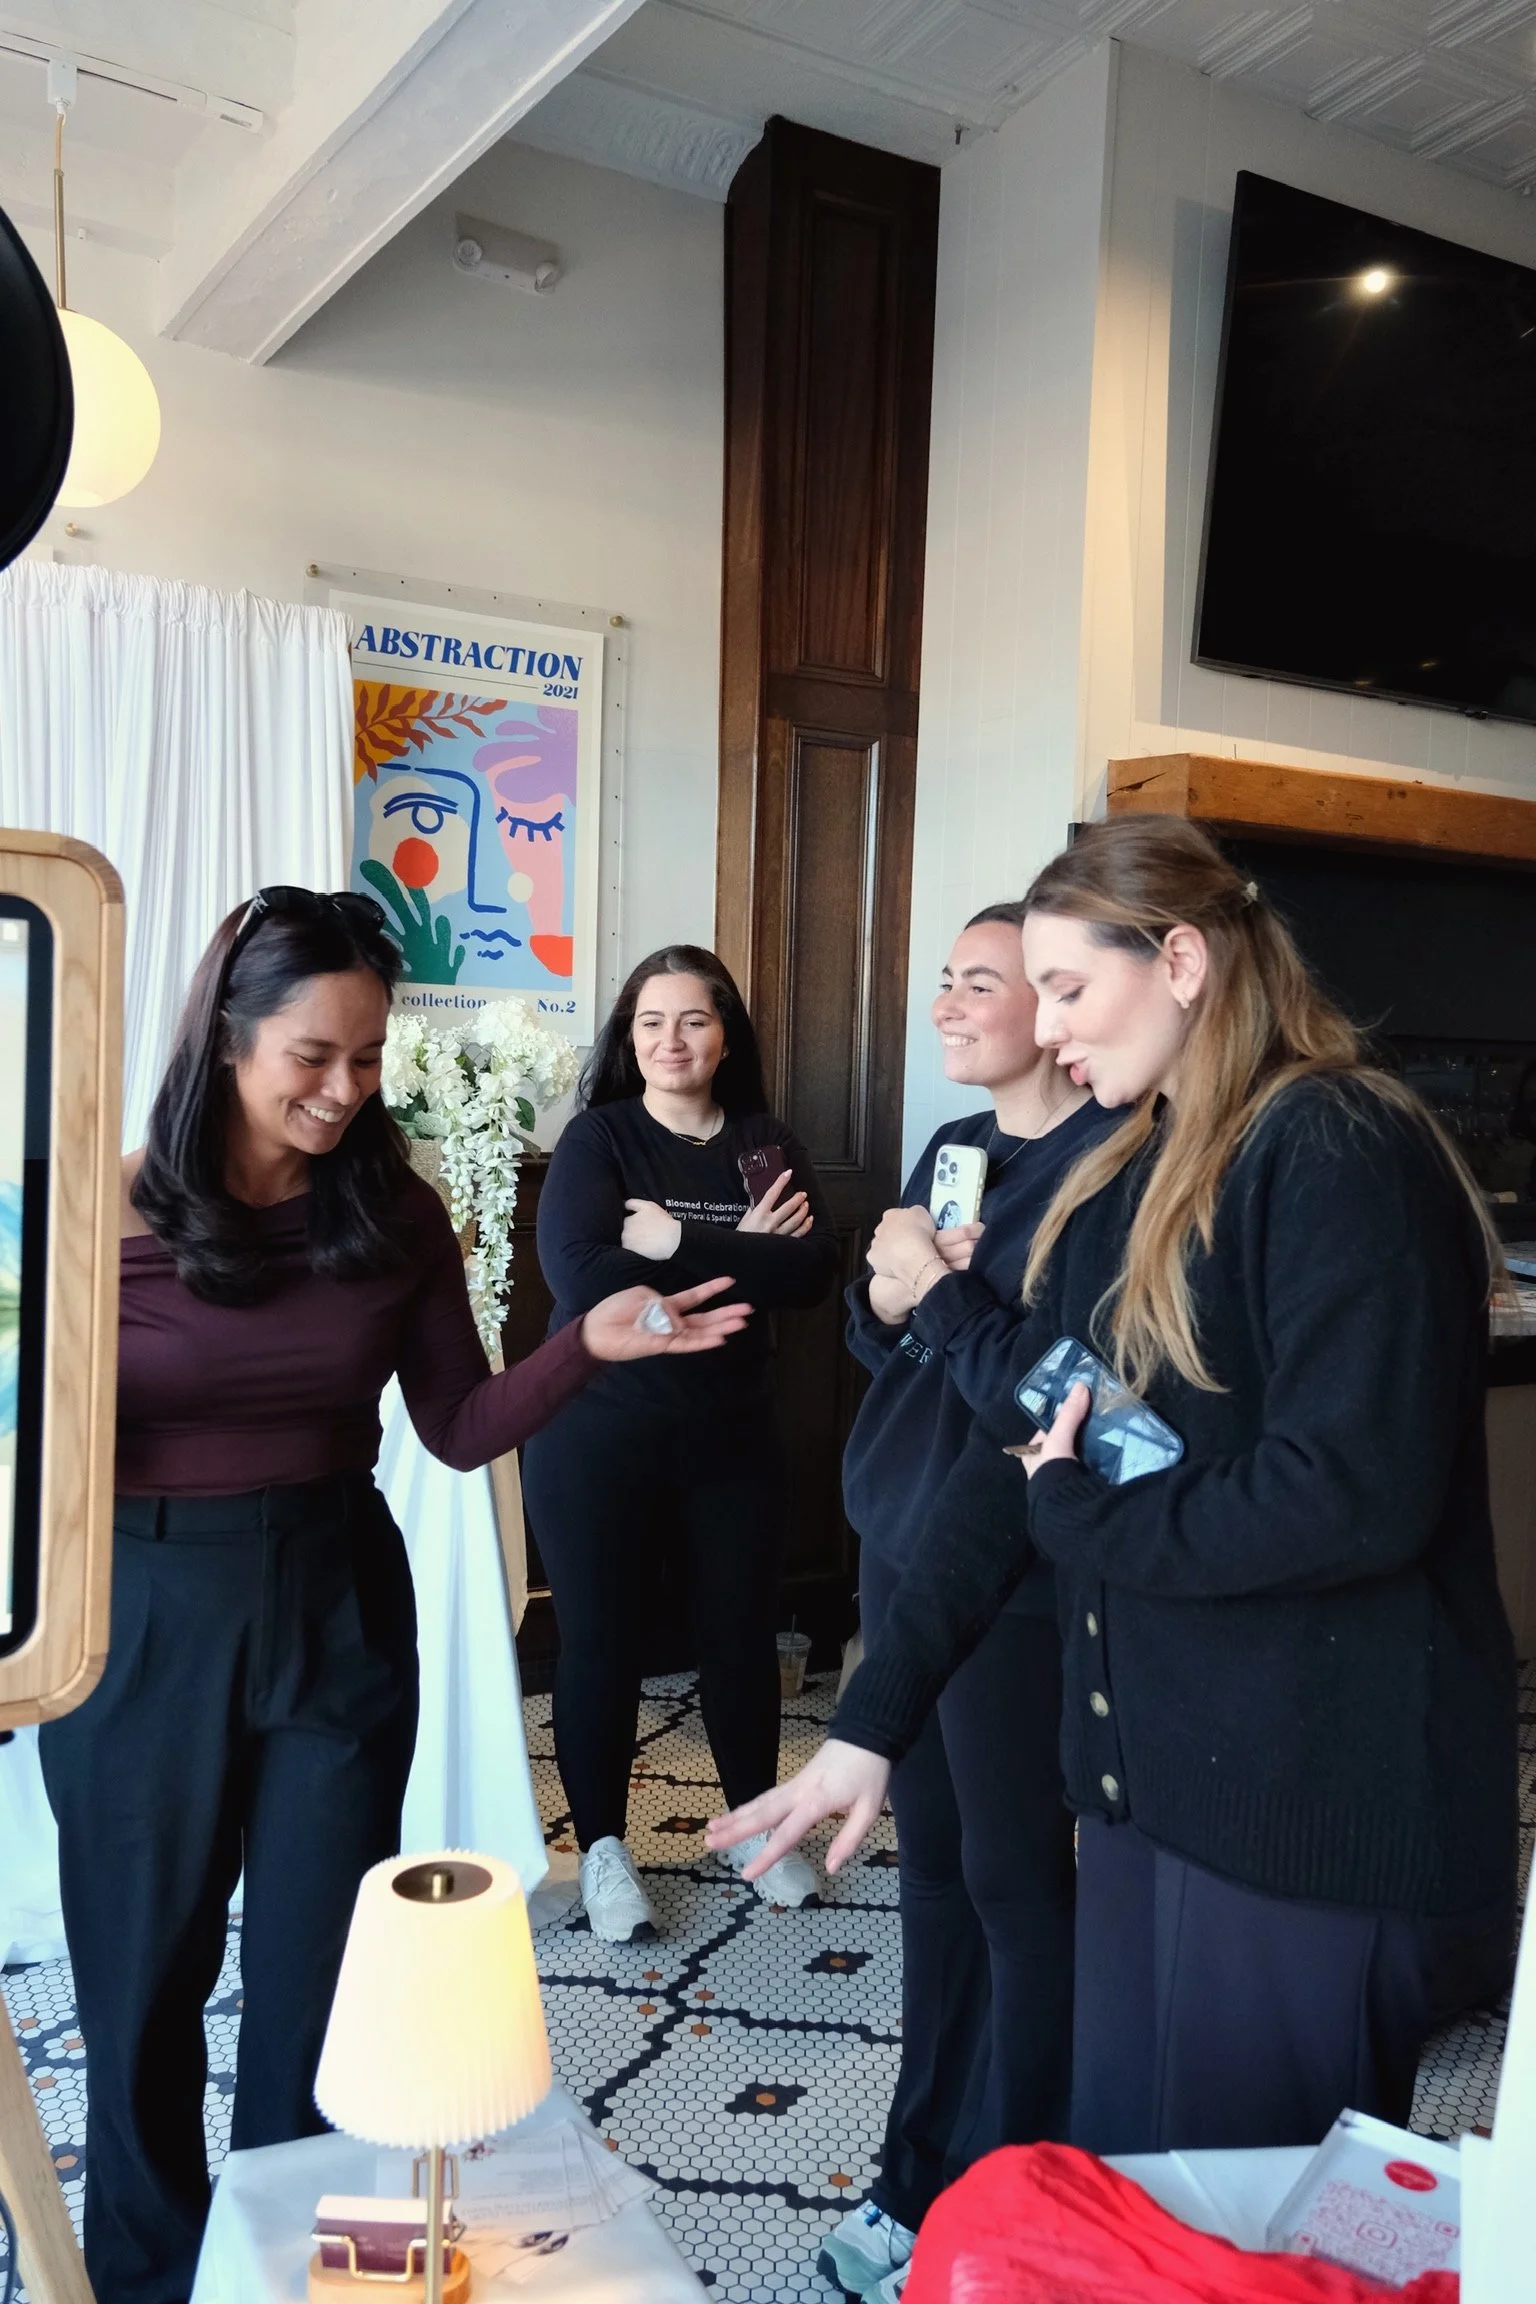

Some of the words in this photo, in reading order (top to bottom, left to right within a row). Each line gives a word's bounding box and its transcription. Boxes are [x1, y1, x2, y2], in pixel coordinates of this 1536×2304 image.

[354, 624, 584, 681] ABSTRACTION
[543, 683, 578, 699] 2021
[401, 993, 487, 1009] collection
[537, 998, 576, 1013] No.2
[665, 1200, 700, 1209] Bloomed
[688, 1211, 705, 1221] Floral
[712, 1214, 732, 1223] Spatial
